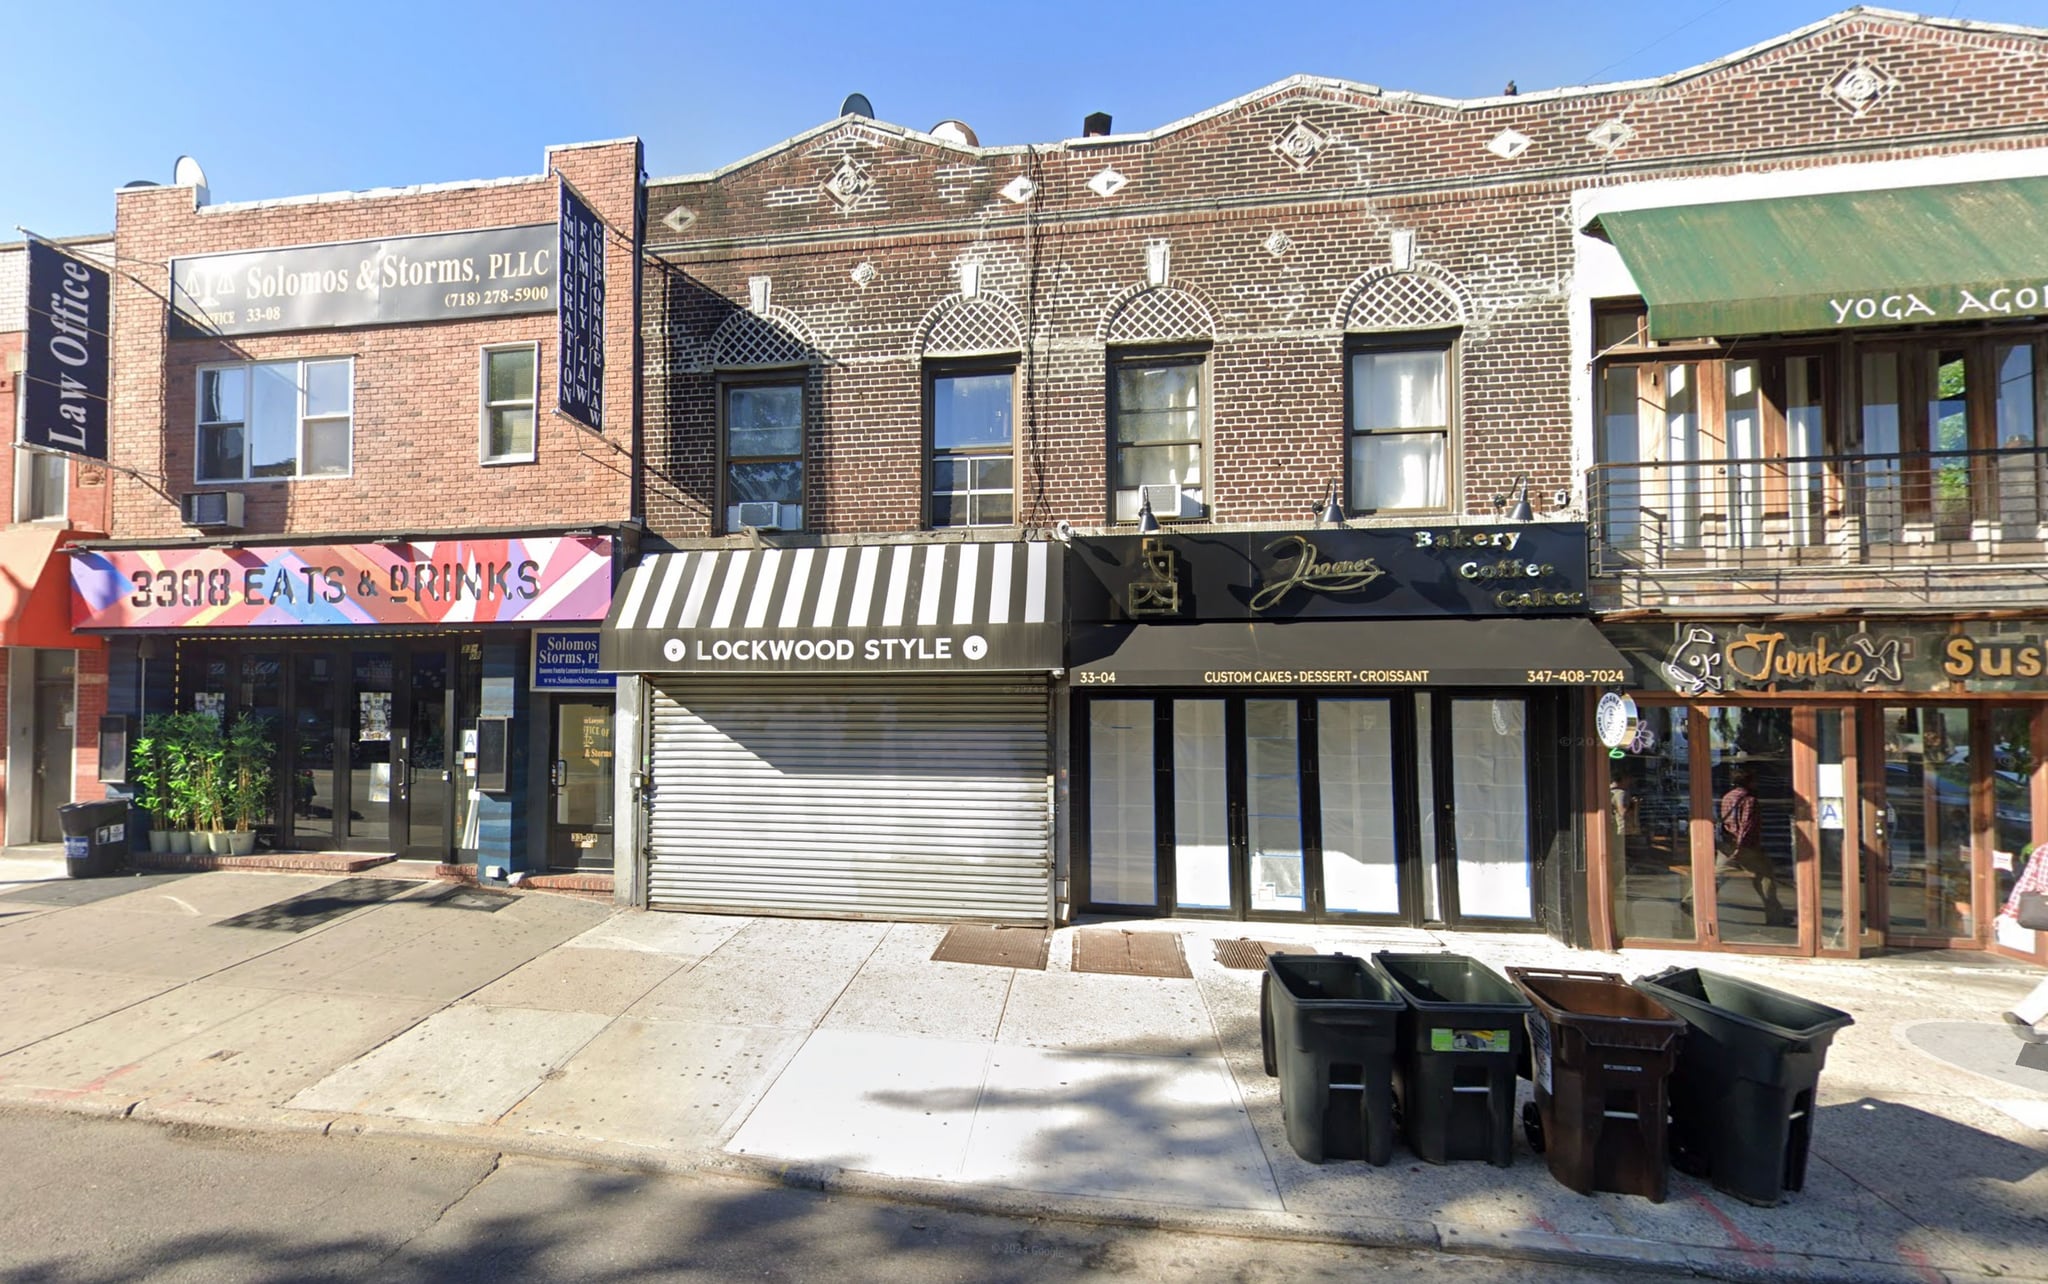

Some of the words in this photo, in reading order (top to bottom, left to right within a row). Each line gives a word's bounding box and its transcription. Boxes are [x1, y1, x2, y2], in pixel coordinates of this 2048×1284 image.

[246, 265, 348, 300] Solomos
[356, 258, 380, 291] &
[382, 253, 481, 289] Storms,
[488, 248, 550, 280] PLLC
[578, 220, 589, 330] FAMILY
[444, 291, 481, 309] (718)
[483, 285, 549, 306] 278-5900
[562, 198, 575, 405] IMMIGRATION
[592, 221, 602, 369] CORPORATE
[1830, 293, 1936, 324] YOGA
[50, 261, 91, 367] Office
[246, 306, 281, 323] 33-08
[575, 345, 588, 404] LAW
[48, 372, 87, 450] Law
[589, 376, 601, 428] LAW
[1414, 529, 1521, 551] Bakery
[1459, 557, 1554, 579] Coffee
[131, 568, 231, 607] 3308
[244, 565, 346, 606] EATS
[357, 569, 379, 597] &
[390, 560, 541, 603] DRINKS
[1496, 587, 1584, 608] Cakes
[539, 650, 586, 665] Storms,
[547, 636, 598, 651] Solomos
[697, 639, 855, 662] LOCKWOOD
[864, 637, 952, 661] STYLE
[1726, 632, 1864, 681] Junko
[1080, 671, 1116, 683] 33-04
[1204, 671, 1252, 683] CUSTOM
[1254, 671, 1292, 683] CAKES
[1299, 671, 1352, 683] DESSERT
[1359, 670, 1429, 682] CROISSANT
[1527, 669, 1625, 683] 347-408-7024
[466, 734, 475, 745] A
[1822, 804, 1837, 820] A
